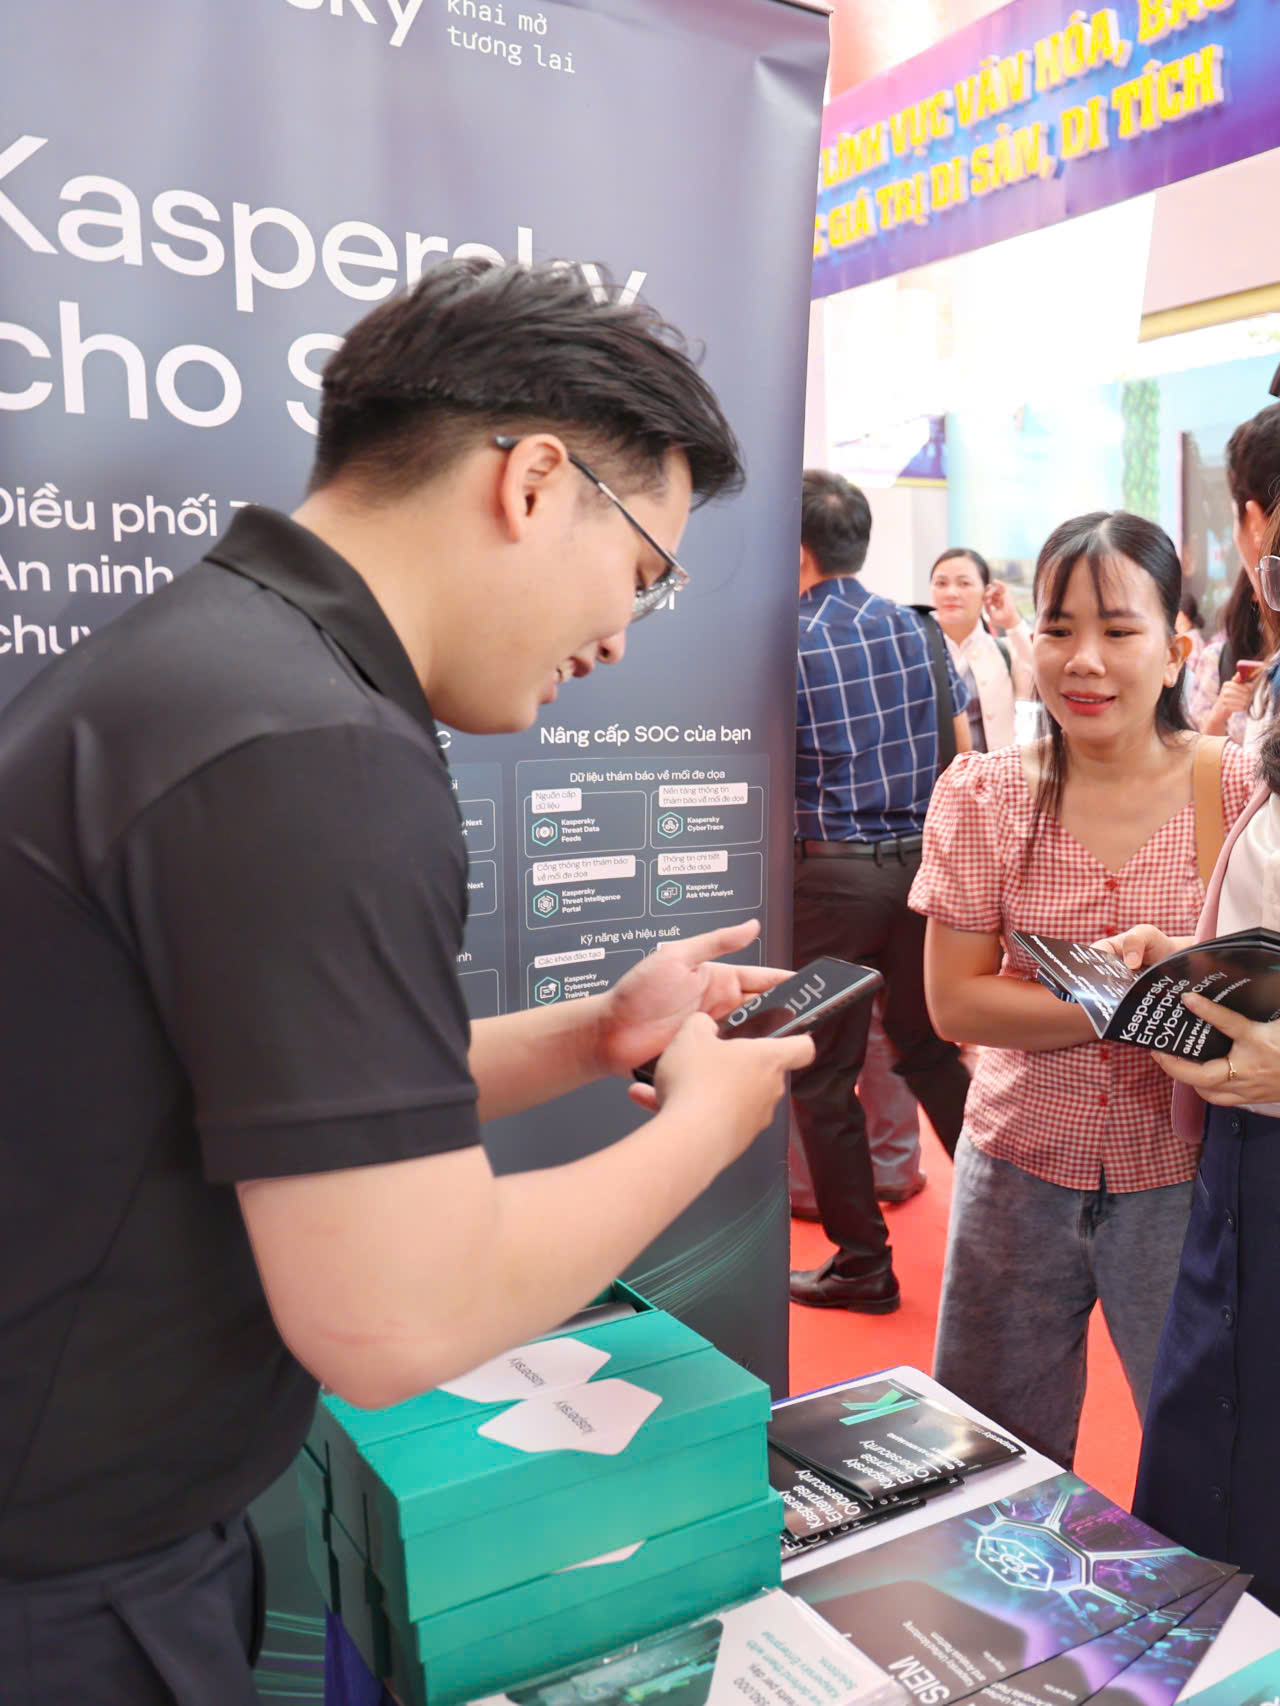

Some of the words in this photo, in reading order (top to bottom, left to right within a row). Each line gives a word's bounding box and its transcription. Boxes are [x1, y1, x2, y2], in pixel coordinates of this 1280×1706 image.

[447, 0, 507, 26] khai
[518, 13, 548, 36] mở
[447, 25, 523, 66] tương
[533, 45, 576, 74] lai
[889, 89, 955, 157] VỰC
[954, 51, 1032, 127] VĂN
[1033, 9, 1133, 92] HÓA,
[828, 187, 878, 250] GIÁ
[875, 171, 930, 231] TRỊ
[930, 155, 970, 212] DI
[970, 121, 1057, 197] SẢN,
[1059, 95, 1110, 160] DI
[1112, 43, 1225, 140] TÍCH
[0, 134, 648, 313] Kasper
[0, 301, 243, 428] cho
[112, 493, 218, 542] phối
[67, 554, 174, 595] ninh
[0, 615, 92, 655] hu
[540, 726, 590, 747] Nâng
[594, 724, 630, 747] cấp
[634, 726, 680, 744] SOC
[684, 725, 716, 743] của
[720, 725, 752, 744] bạn
[606, 770, 633, 783] thám
[635, 770, 655, 782] báo
[657, 769, 670, 781] về
[671, 769, 691, 781] mối
[692, 769, 706, 780] đe
[706, 769, 726, 782] dọa
[465, 819, 483, 827] Next
[561, 817, 596, 829] Kaspersky
[561, 826, 582, 835] Threat
[584, 825, 600, 833] Data
[687, 815, 720, 826] Kaspersky
[467, 881, 484, 890] Next
[562, 887, 596, 898] Kaspersky
[562, 896, 582, 905] Threat
[686, 882, 719, 893] Kaspersky
[580, 933, 593, 946] Kỹ
[595, 932, 620, 945] năng
[621, 930, 634, 941] và
[635, 928, 656, 943] hiệu
[657, 926, 681, 938] suất
[564, 973, 597, 984] Kaspersky
[1119, 974, 1175, 1042] Kaspersky
[1136, 978, 1190, 1046] Enterprise
[1154, 970, 1228, 1049] Cybercurity
[842, 1458, 897, 1489] Kaspersky
[859, 1440, 930, 1479] Cybersecurity
[860, 1452, 914, 1485] Enterprise
[779, 1490, 824, 1529] Kaspersky
[793, 1484, 844, 1524] Enterprise
[794, 1469, 861, 1516] Cybersecurity
[887, 1655, 951, 1705] SIEM
